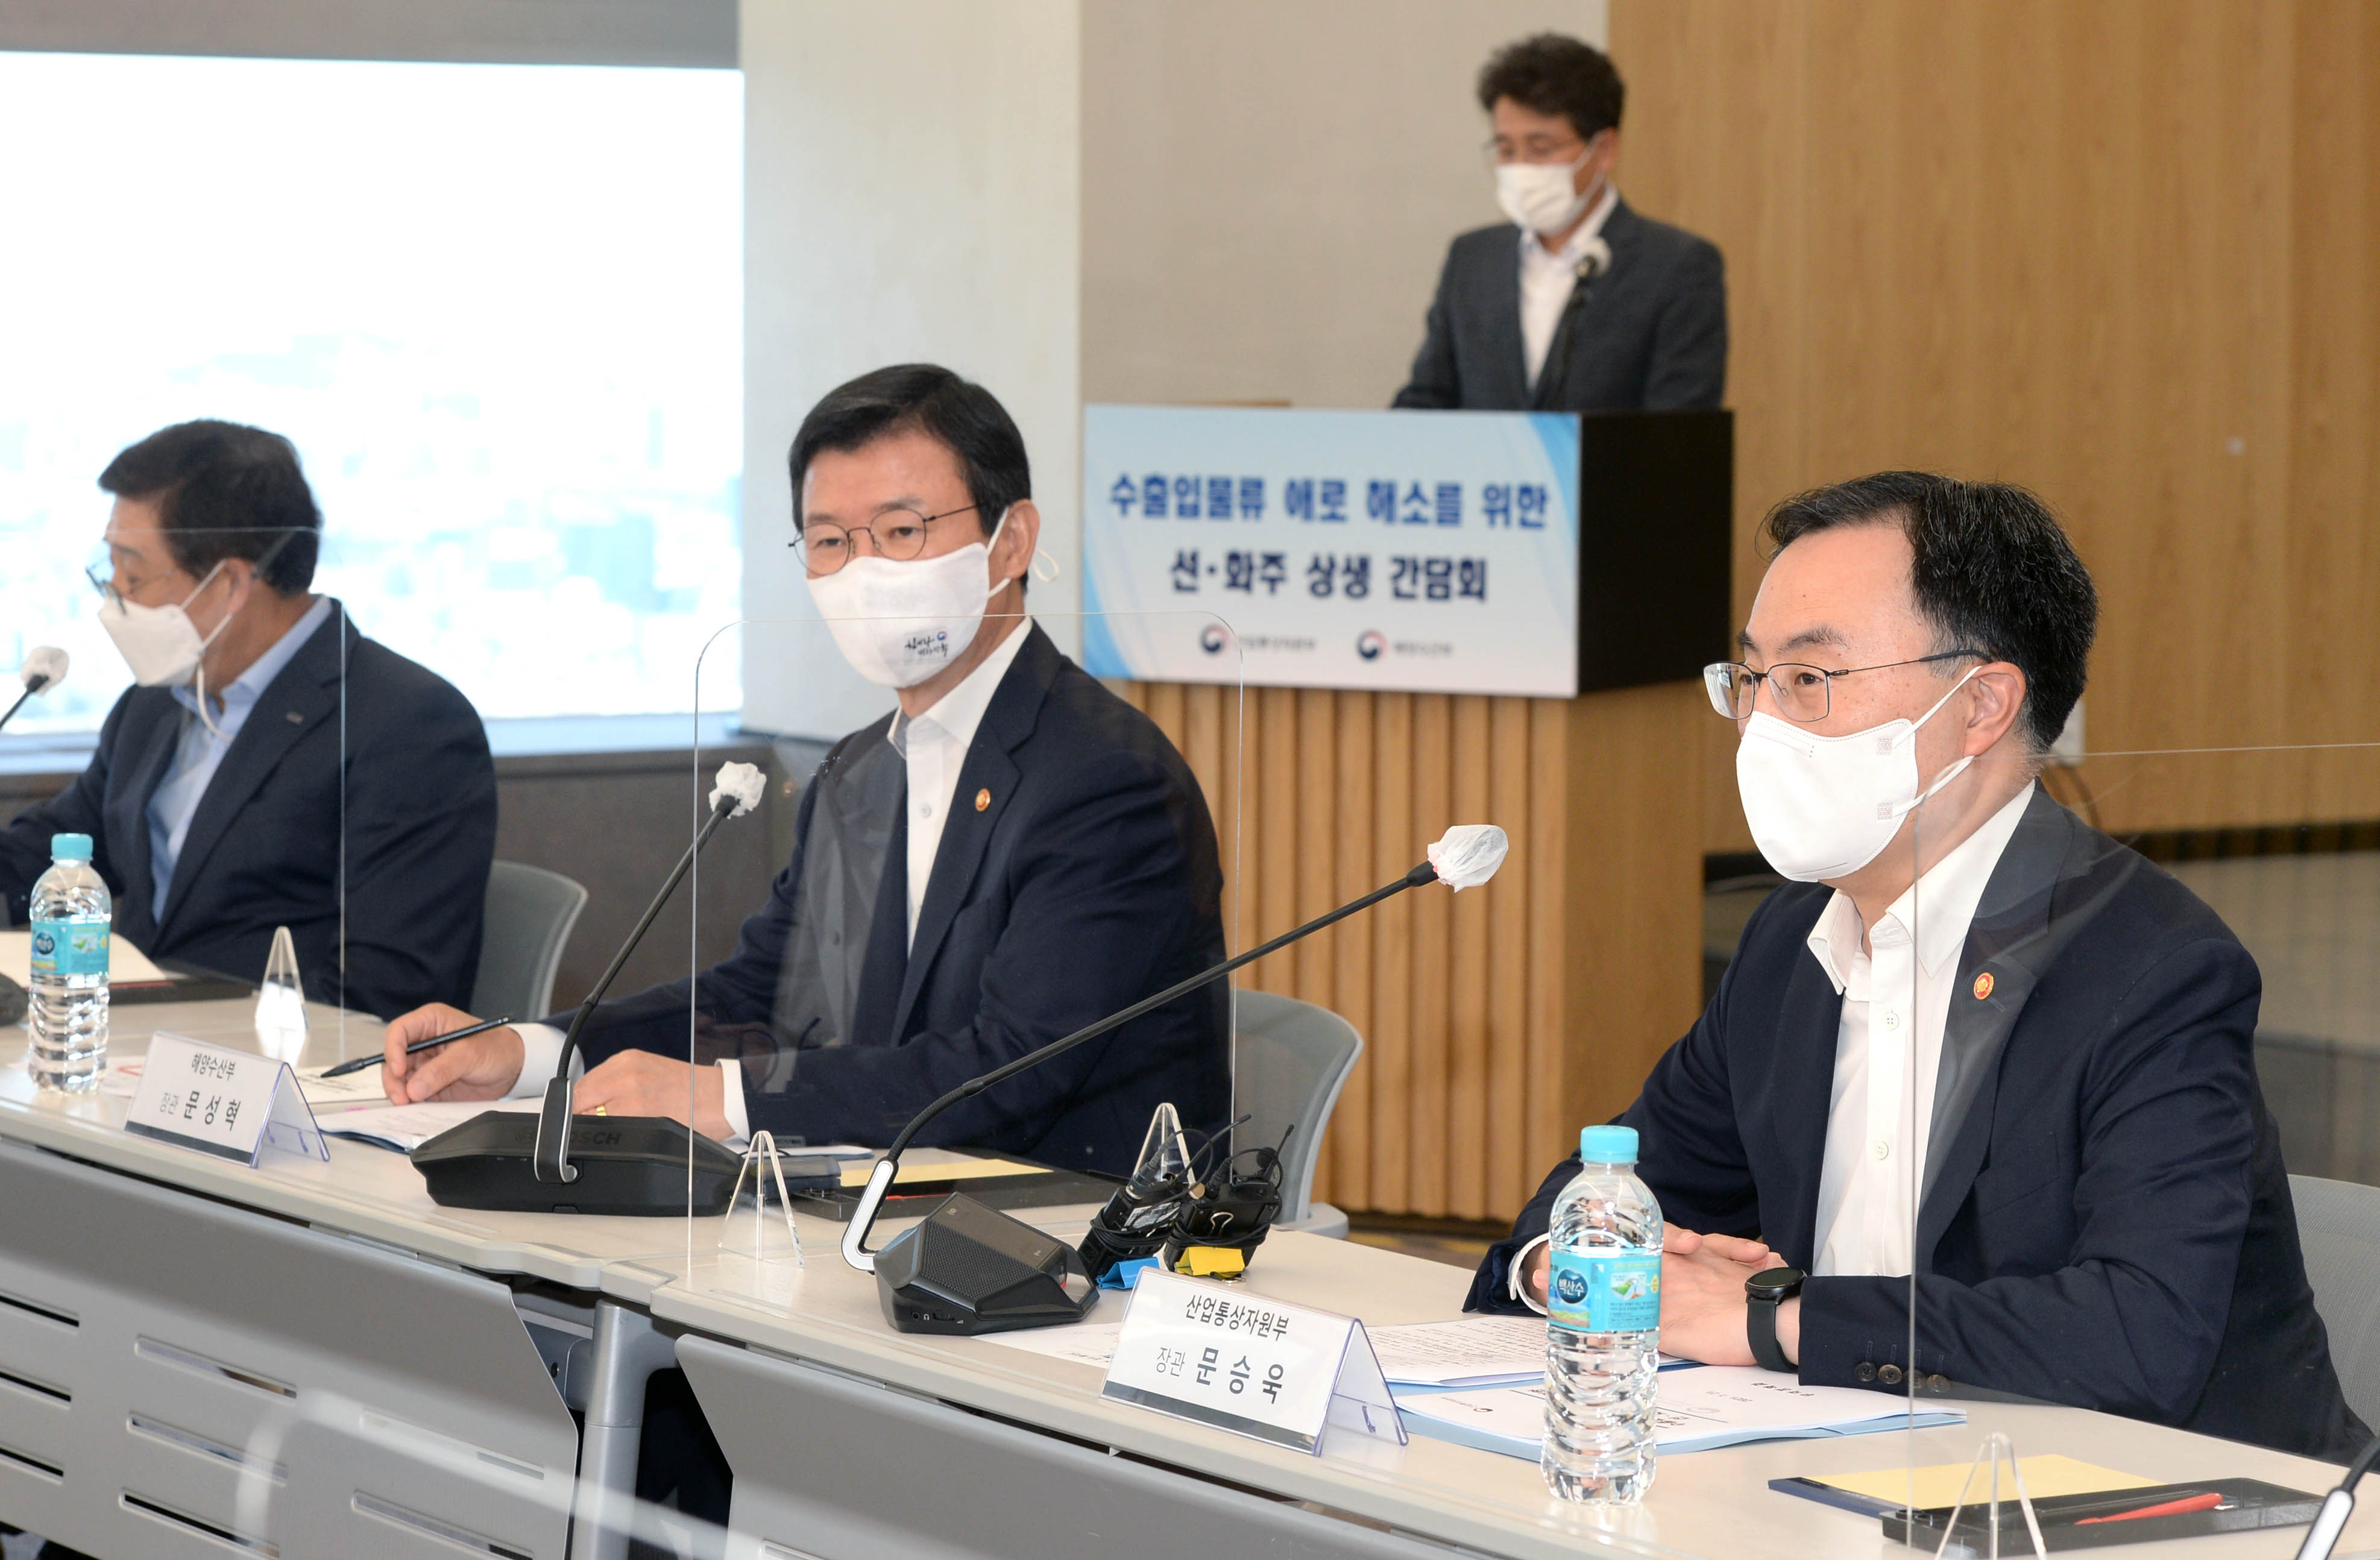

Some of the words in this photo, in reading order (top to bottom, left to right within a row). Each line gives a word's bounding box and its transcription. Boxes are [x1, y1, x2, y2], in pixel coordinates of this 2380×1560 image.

[1111, 474, 1264, 520] 수출입물류
[1285, 479, 1347, 522] 애로
[1368, 480, 1461, 526] 해소를
[1482, 484, 1547, 529] 위한
[1306, 553, 1370, 599] 상생
[1390, 557, 1487, 600] 간담회
[191, 1054, 236, 1080] 해양수산부
[1558, 1278, 1585, 1297] 백산수
[1185, 1295, 1289, 1341] 산업통상자원부
[1156, 1347, 1186, 1377] 장관
